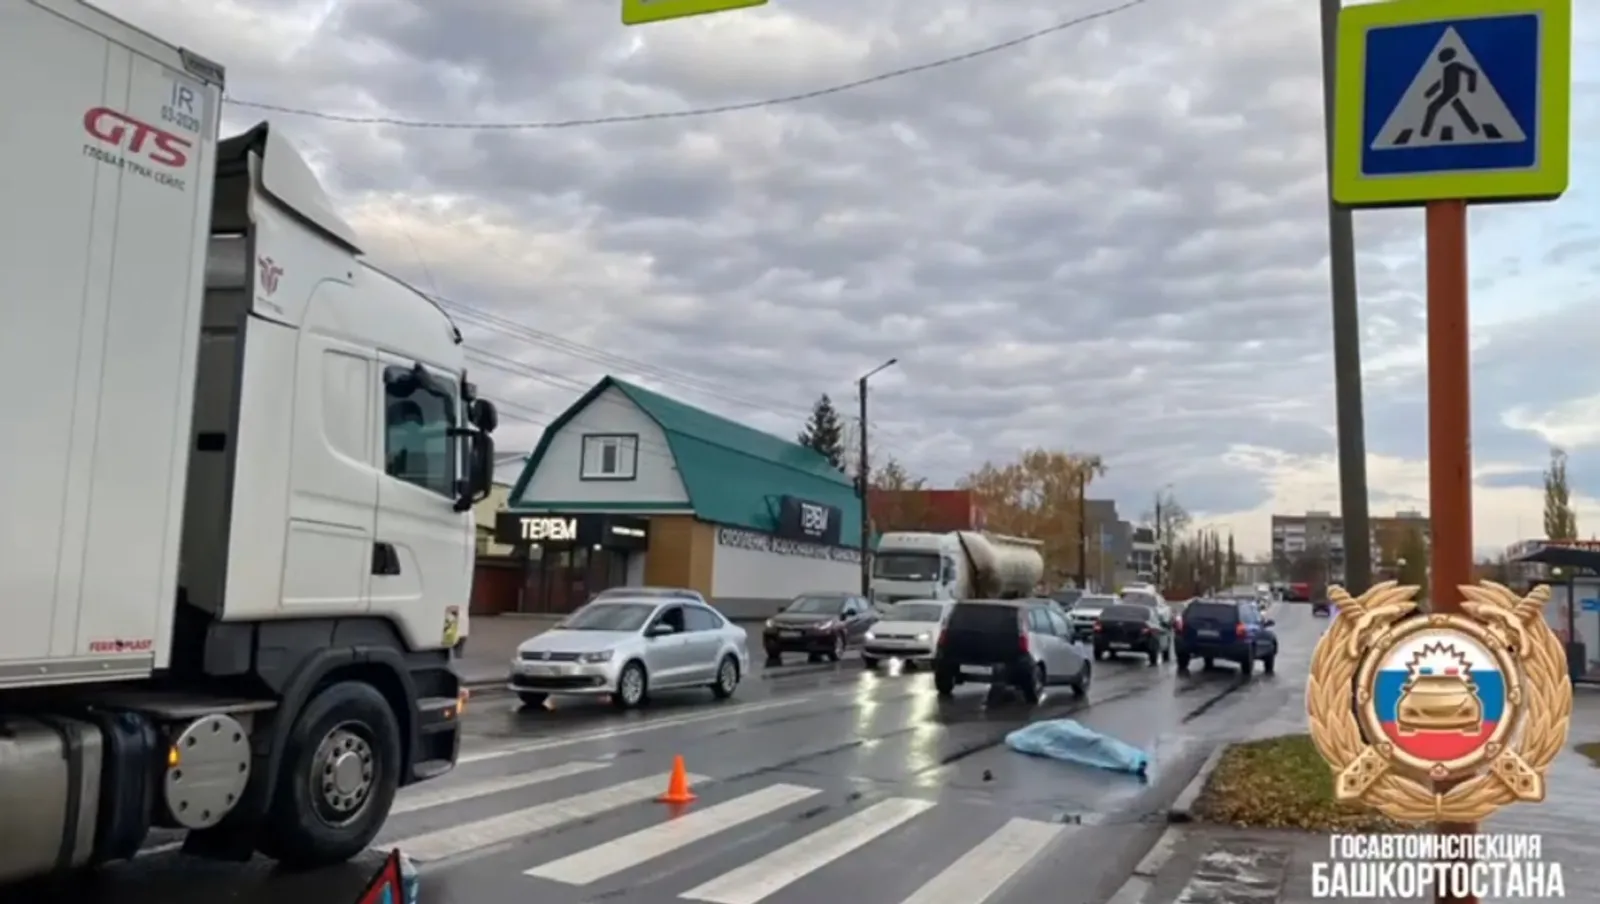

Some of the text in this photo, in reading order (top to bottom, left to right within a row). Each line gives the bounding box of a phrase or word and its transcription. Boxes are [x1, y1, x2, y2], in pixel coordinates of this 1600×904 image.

[171, 81, 194, 114] IR
[83, 106, 192, 168] GTS
[83, 144, 125, 168] ГЛОБАЛ
[519, 516, 578, 541] ТЕРЕМ
